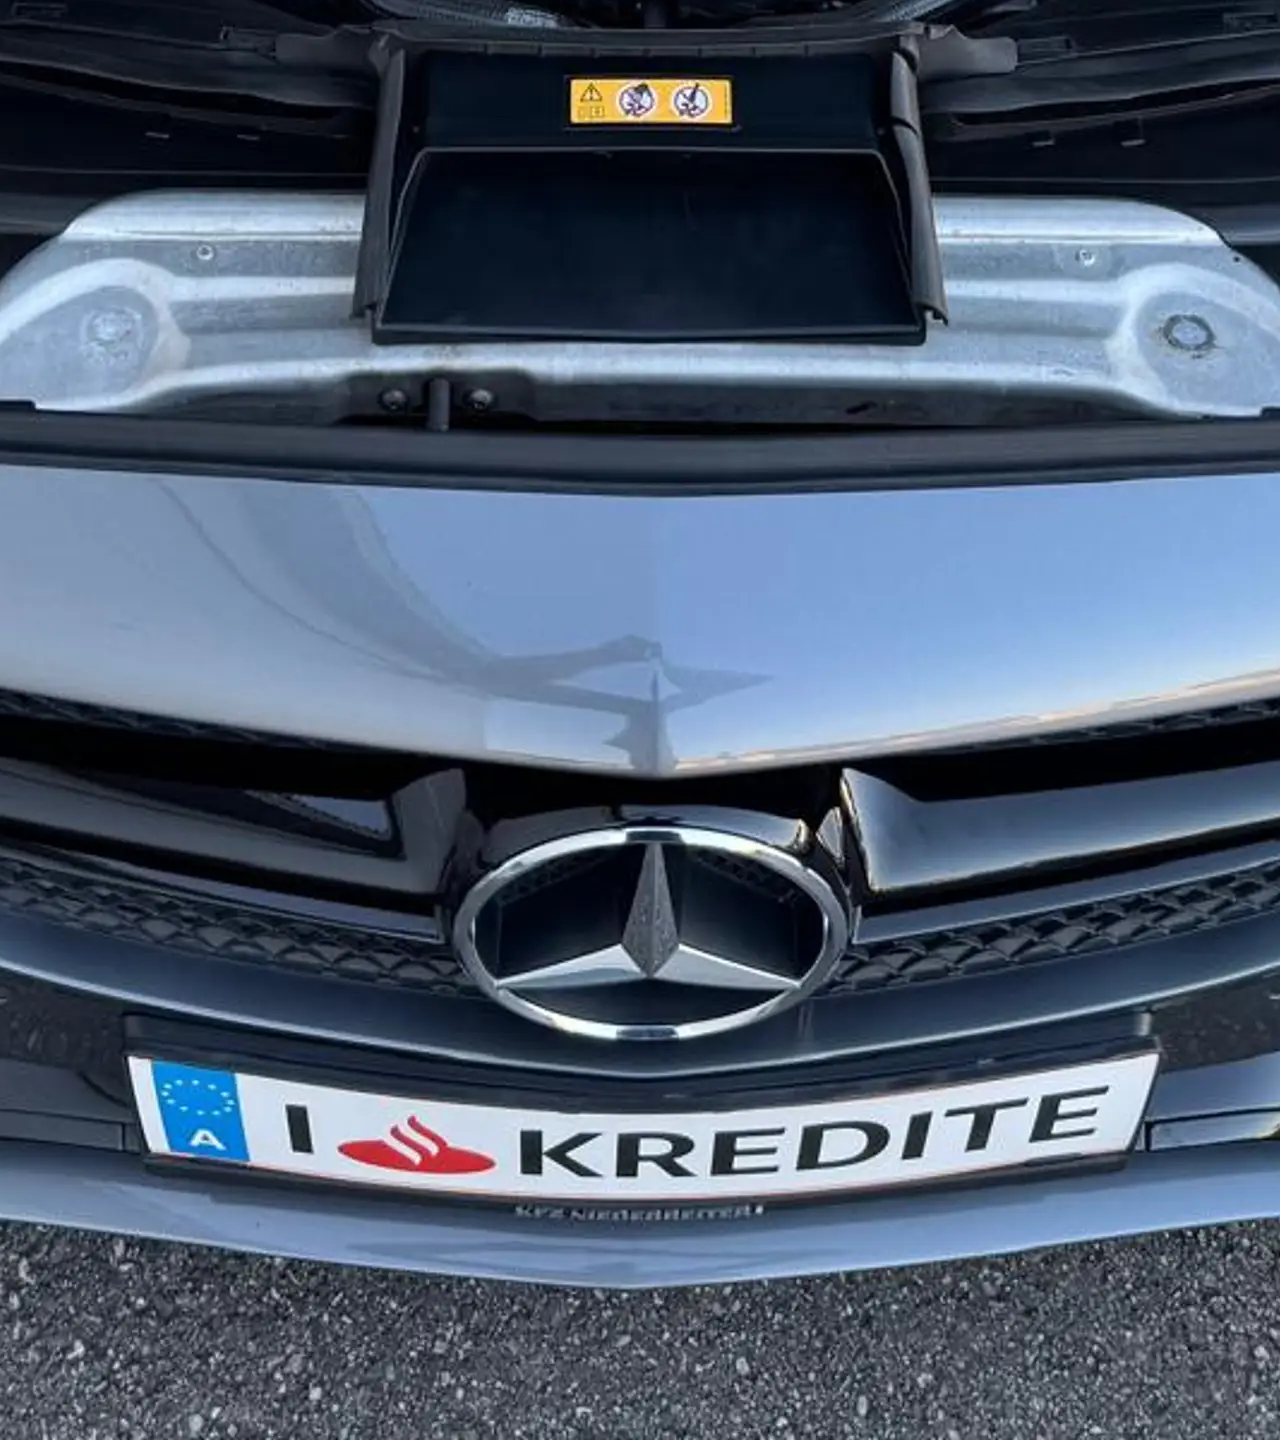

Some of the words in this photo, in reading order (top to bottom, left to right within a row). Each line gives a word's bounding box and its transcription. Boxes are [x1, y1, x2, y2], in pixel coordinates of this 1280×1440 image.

[189, 1128, 226, 1150] A
[285, 1104, 314, 1154] I
[519, 1085, 1110, 1178] KREDITE
